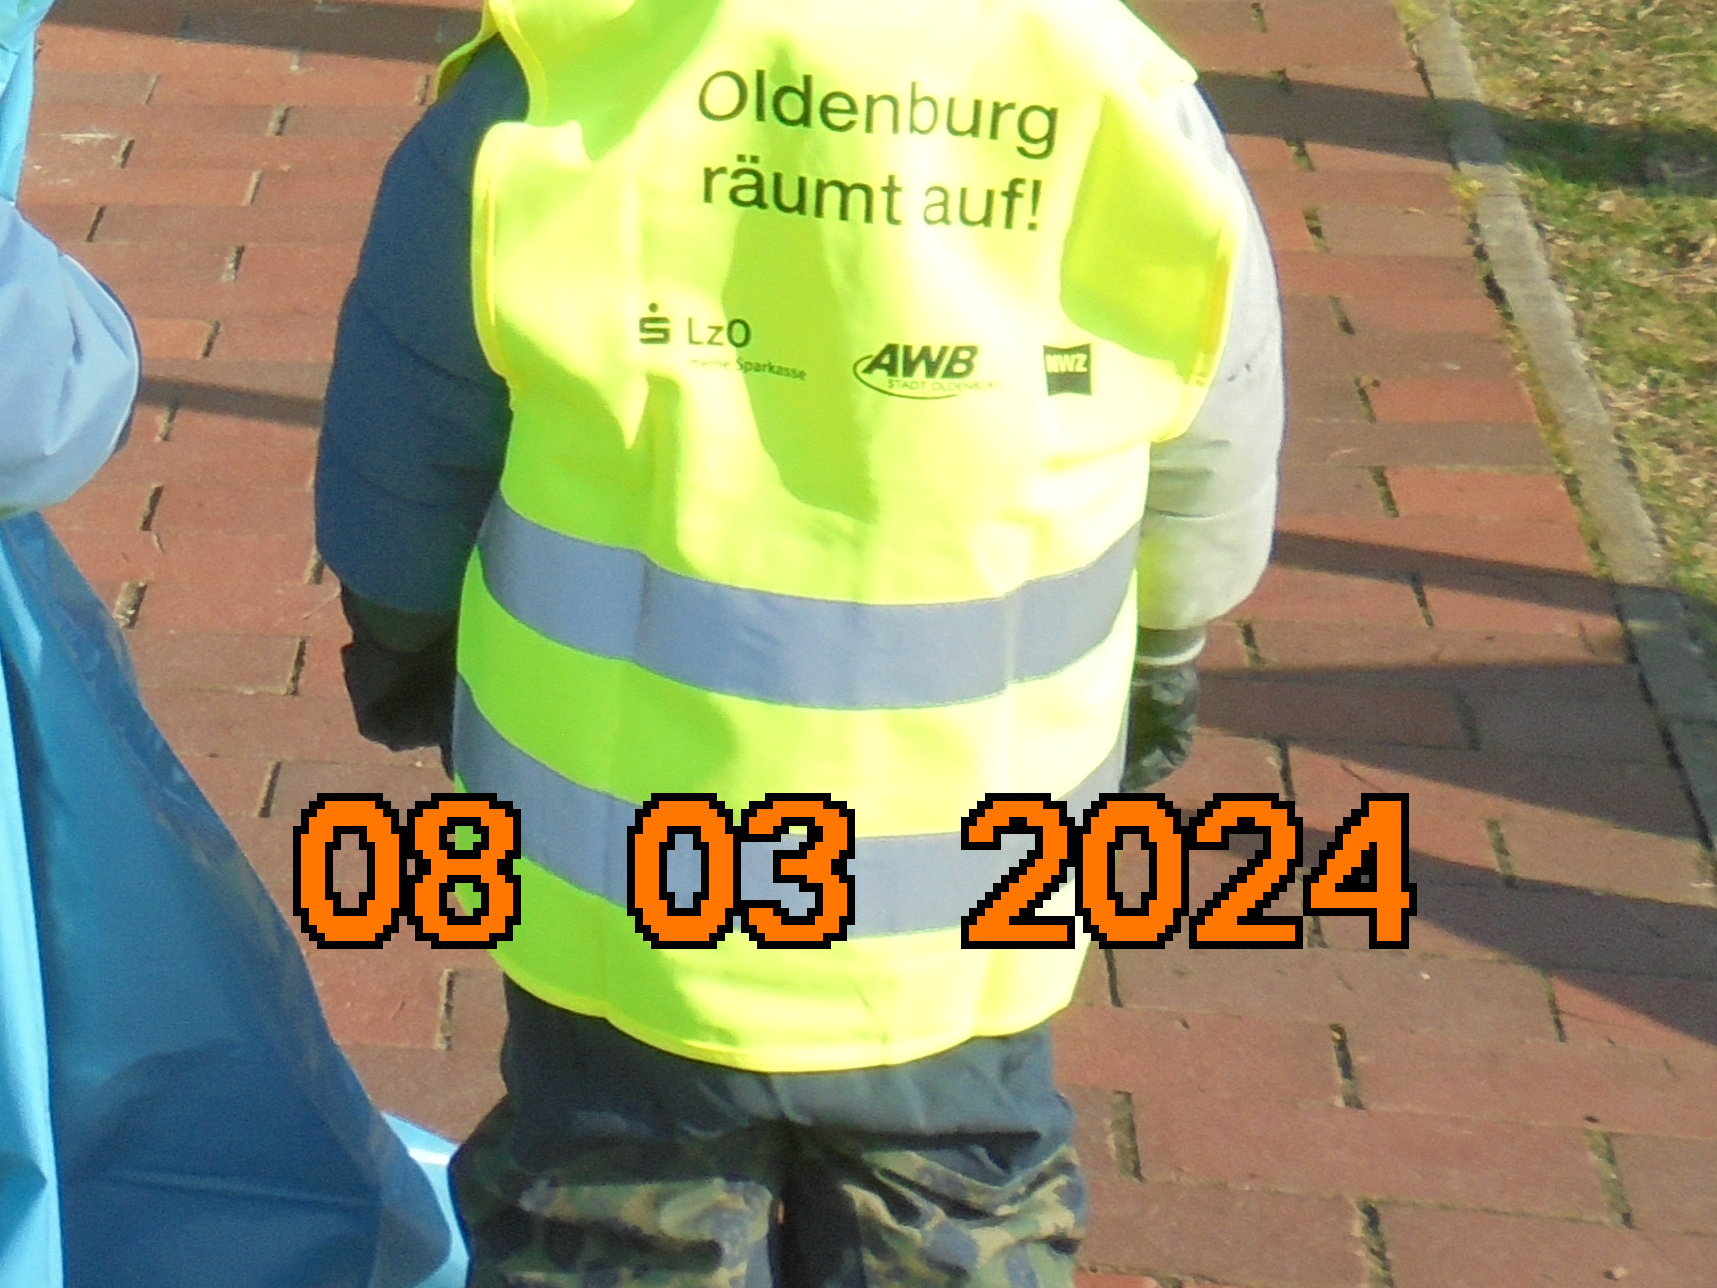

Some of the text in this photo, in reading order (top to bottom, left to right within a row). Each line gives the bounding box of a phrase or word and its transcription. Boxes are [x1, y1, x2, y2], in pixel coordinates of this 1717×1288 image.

[698, 69, 1059, 160] Oldenburg
[701, 154, 1043, 232] räumt auf!
[735, 356, 807, 381] Sparkasse
[861, 342, 979, 379] AWB
[1045, 353, 1088, 373] NWZ
